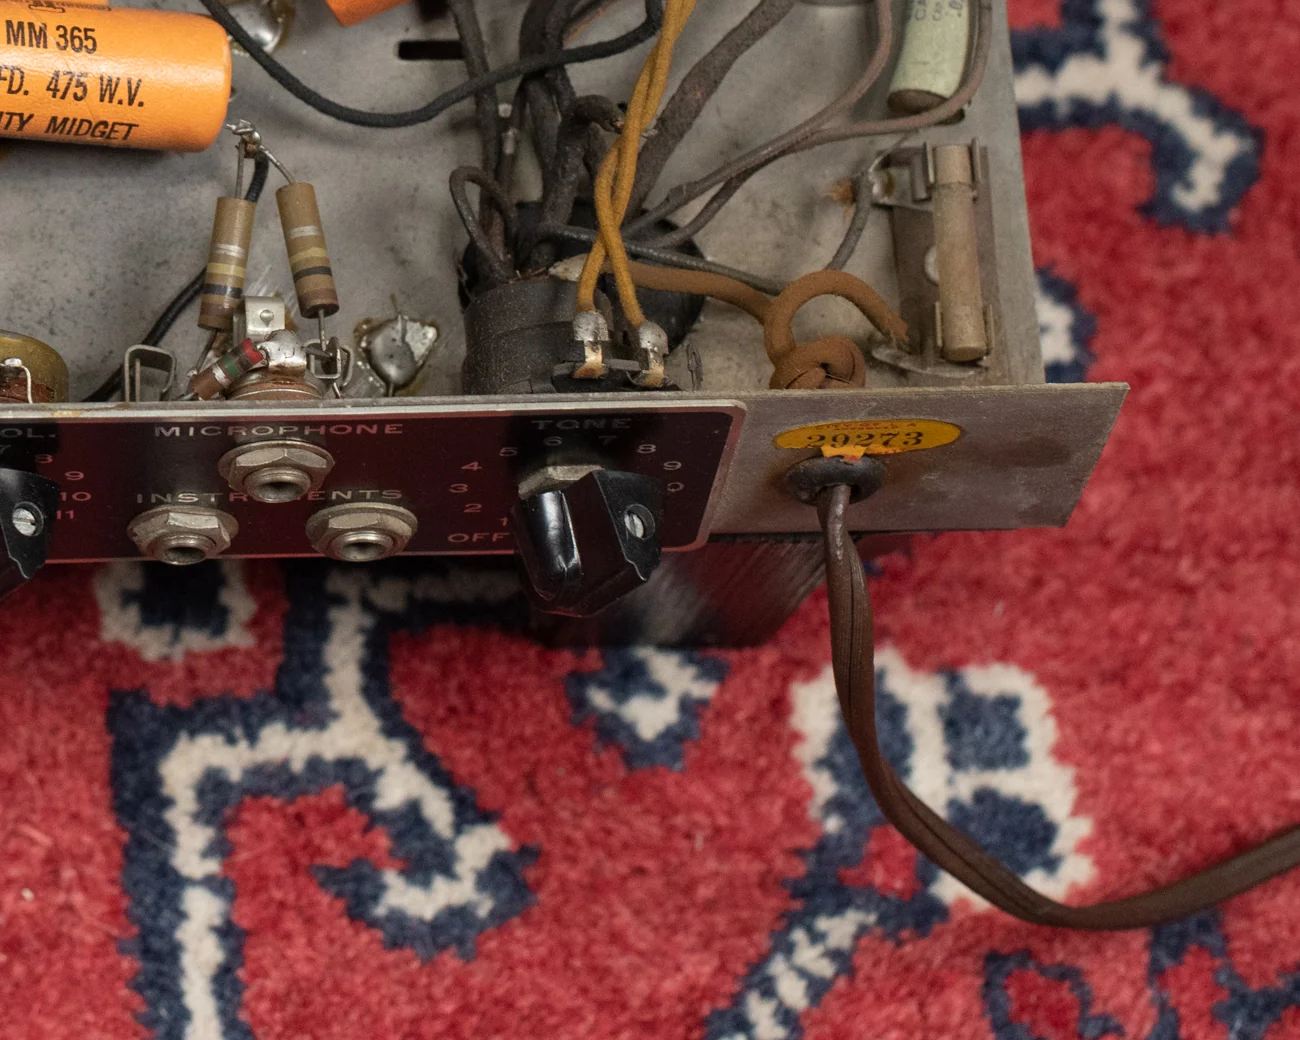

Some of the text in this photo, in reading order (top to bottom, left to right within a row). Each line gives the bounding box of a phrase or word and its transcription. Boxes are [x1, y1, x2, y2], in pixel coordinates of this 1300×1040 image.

[5, 19, 98, 54] MM 365
[45, 69, 90, 102] 475
[98, 71, 146, 108] W.V.
[43, 115, 140, 142] MIDGET
[530, 418, 633, 431] TONE
[154, 423, 405, 437] MICROPHONE
[543, 436, 563, 446] 6
[807, 431, 924, 449] 29273
[499, 447, 518, 457] 5
[636, 444, 657, 454] 8
[461, 461, 483, 471] 4
[663, 461, 683, 471] 9
[64, 471, 85, 481] 9
[449, 483, 469, 493] 3
[59, 491, 92, 502] 10
[136, 489, 403, 503] INSTRENTS
[463, 503, 483, 513] 2
[54, 510, 75, 520] 11
[447, 532, 511, 543] OFF
